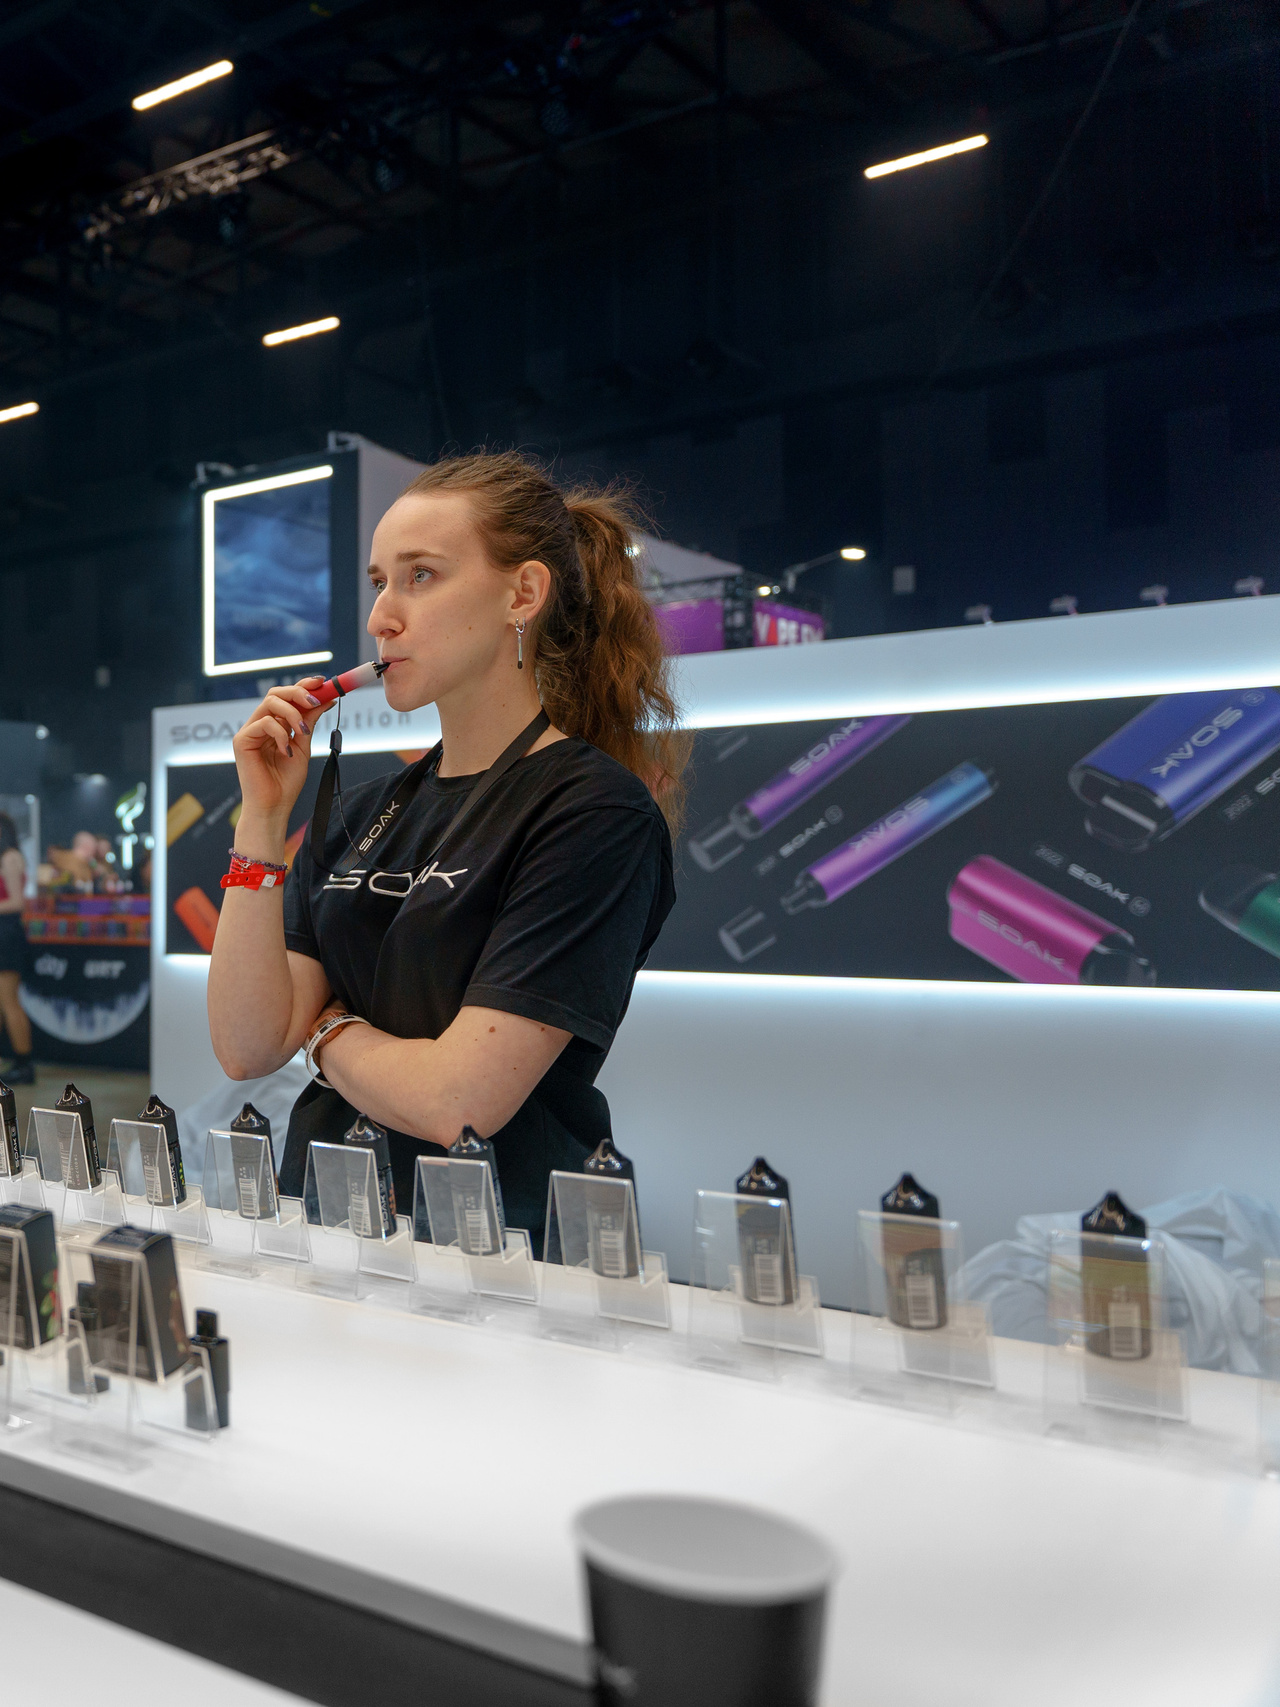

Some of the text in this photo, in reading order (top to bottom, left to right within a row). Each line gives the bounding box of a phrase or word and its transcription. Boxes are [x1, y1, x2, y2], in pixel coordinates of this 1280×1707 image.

[171, 722, 243, 745] SOA
[788, 719, 863, 776] SOAK
[1150, 706, 1243, 778] SOAK
[359, 801, 400, 852] SOAK
[780, 817, 829, 858] SOAK
[848, 795, 930, 852] SOAK
[1067, 863, 1130, 904] SOAK
[977, 909, 1066, 972] SOAK
